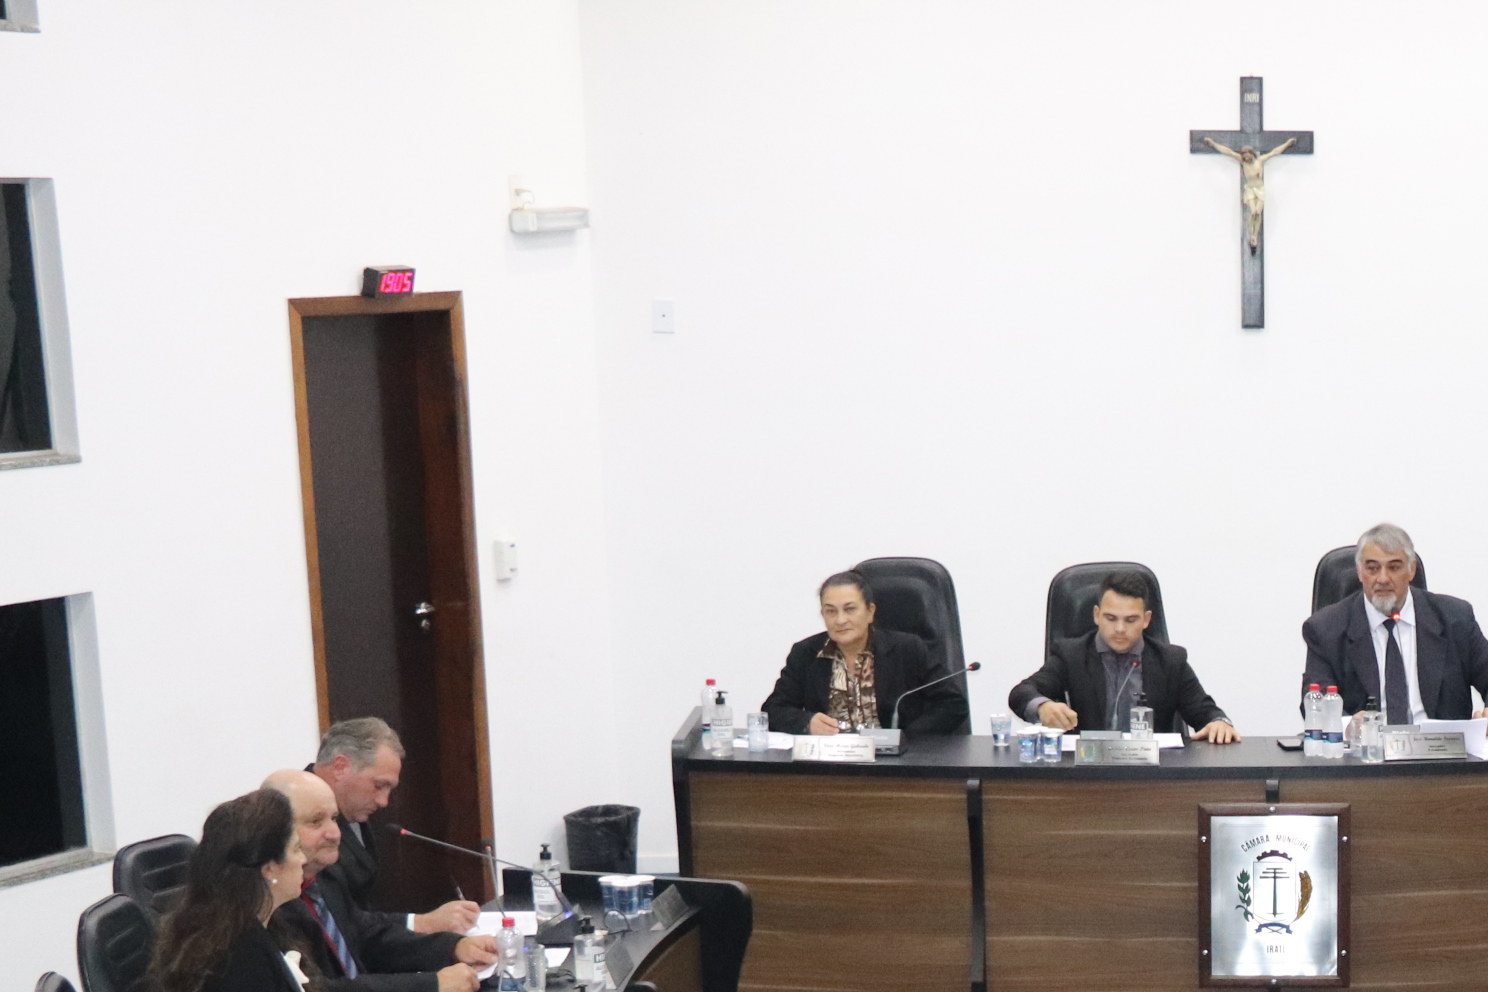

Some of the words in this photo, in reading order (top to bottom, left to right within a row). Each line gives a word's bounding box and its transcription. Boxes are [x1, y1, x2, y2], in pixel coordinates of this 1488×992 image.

[1244, 92, 1260, 103] INRI
[379, 271, 414, 293] 1905
[1275, 834, 1311, 853] MUNICIPAL
[1266, 945, 1285, 954] IRATI
